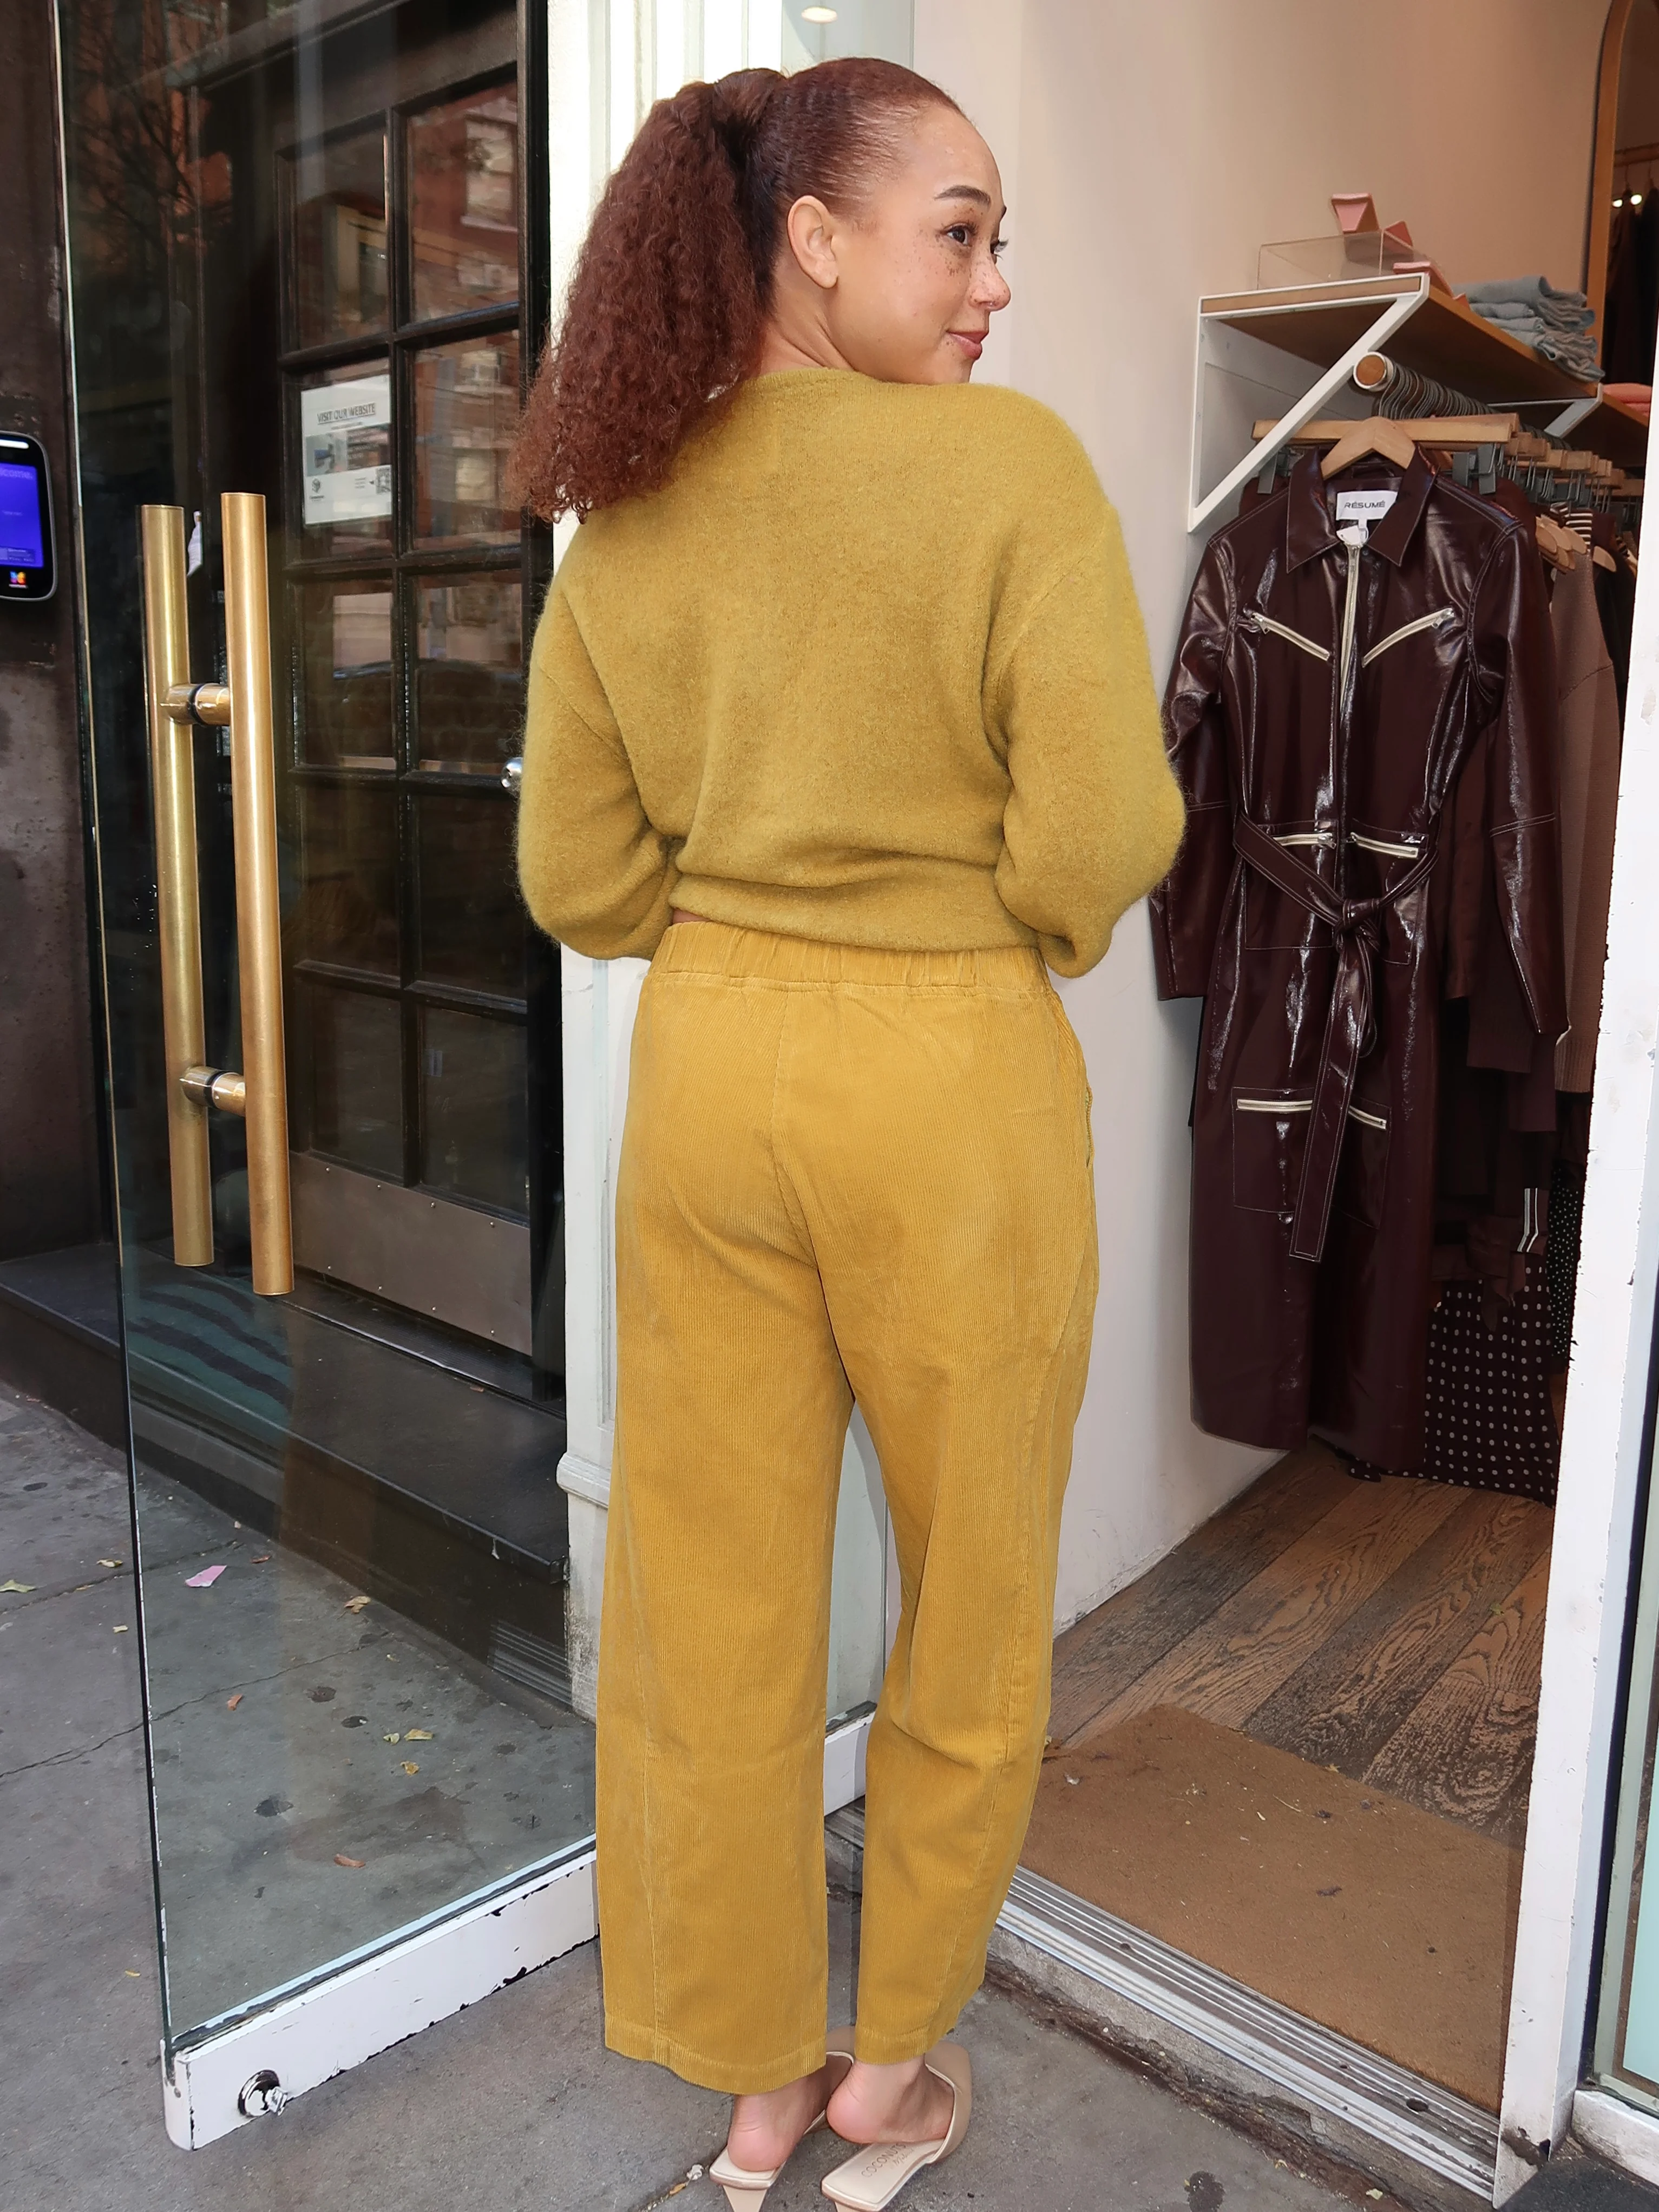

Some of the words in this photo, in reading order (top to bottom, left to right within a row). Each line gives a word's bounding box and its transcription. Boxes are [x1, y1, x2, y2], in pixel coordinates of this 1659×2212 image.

[317, 410, 332, 422] VISIT
[333, 408, 347, 420] OUR
[348, 403, 375, 416] WEBSITE
[1344, 500, 1386, 508] RÉSUMÉ
